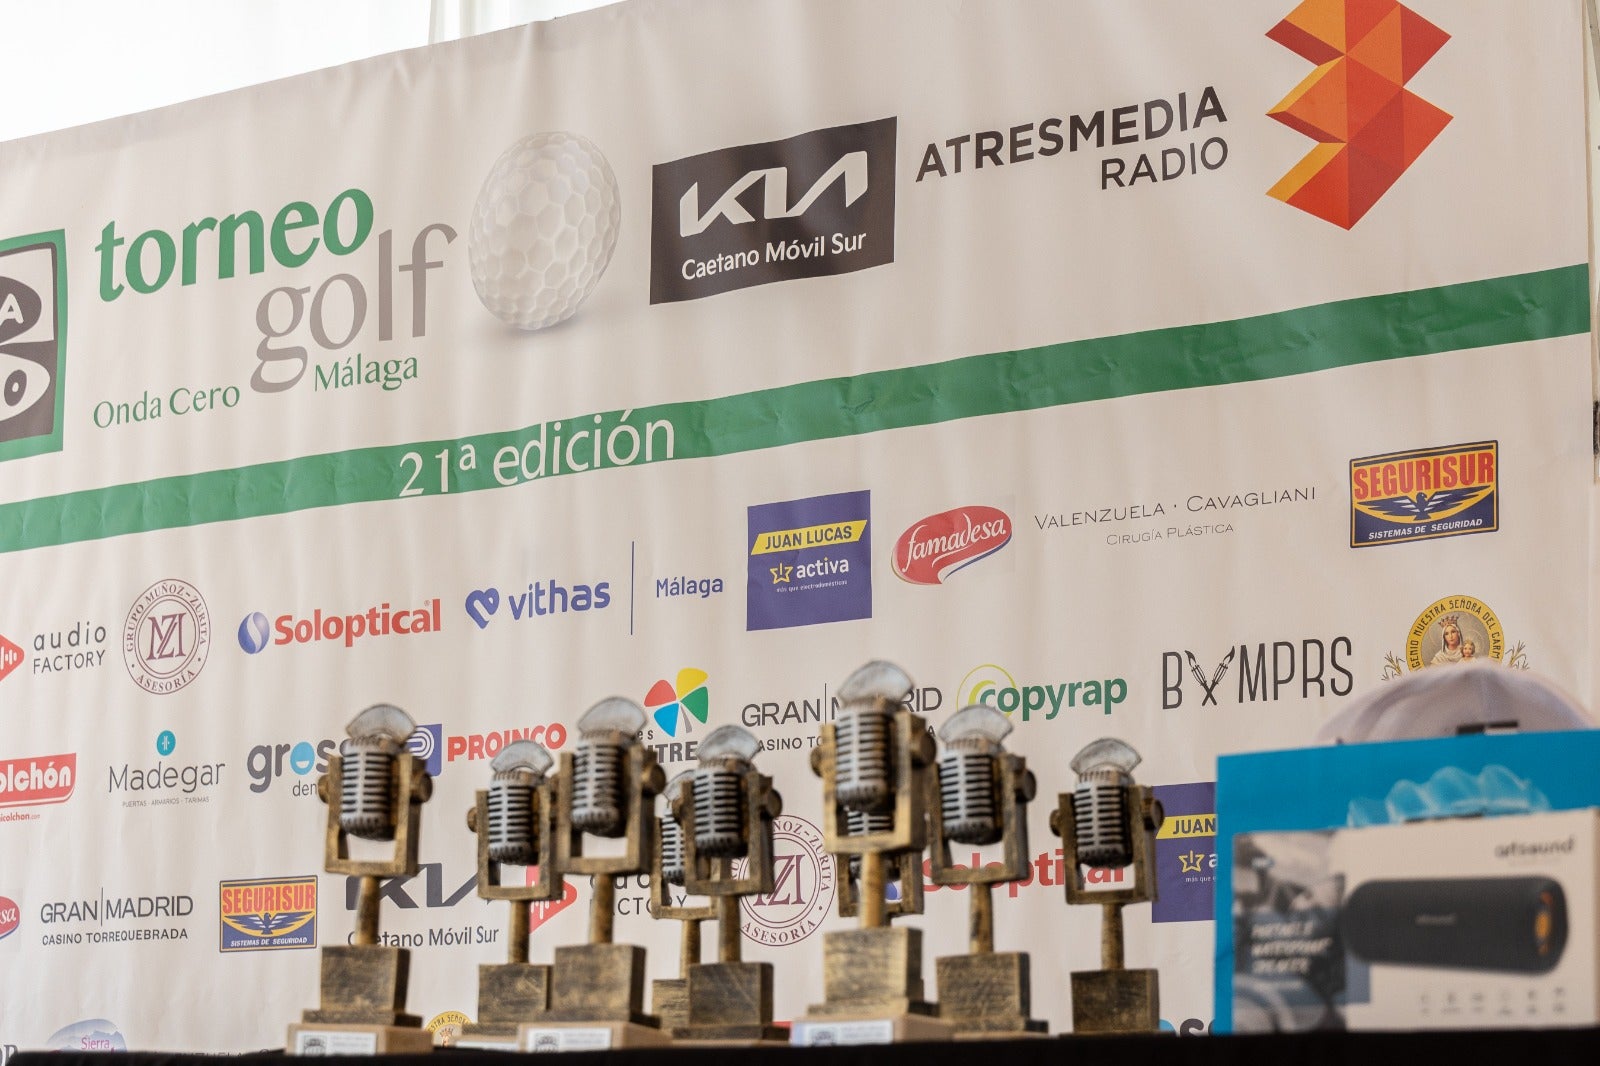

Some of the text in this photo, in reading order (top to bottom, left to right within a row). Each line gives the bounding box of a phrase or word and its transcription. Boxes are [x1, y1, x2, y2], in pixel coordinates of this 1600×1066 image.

[916, 86, 1227, 182] ATRESMEDIA
[1101, 136, 1228, 190] RADIO
[679, 150, 868, 237] KIA
[95, 188, 374, 302] torneo
[681, 232, 866, 280] Caetano Móvil Sur
[250, 223, 457, 393] golf
[314, 353, 419, 391] Málaga
[93, 385, 240, 429] Onda Cero
[399, 409, 675, 497] 21ª edición
[1353, 452, 1494, 500] SEGURISUR
[1034, 486, 1316, 530] VALENZUELA CAVAGLIANI
[765, 525, 852, 550] JUAN LUCAS
[902, 512, 1007, 573] famadesa
[1368, 518, 1483, 540] SISTEMAS DE SEGURIDAD
[796, 557, 850, 579] activa
[508, 579, 611, 621] vithas
[655, 576, 724, 598] Málaga
[34, 621, 106, 651] audio
[127, 604, 144, 652] GRUPO
[275, 598, 441, 647] Soloptical
[1409, 598, 1502, 669] GENIO NUESTRA SEÑORA DEL CARM
[33, 649, 106, 674] FACTORY
[136, 669, 196, 692] ASESORÍA
[741, 699, 820, 727] GRAN
[979, 677, 1128, 721] copyrap
[648, 740, 699, 763] TRE
[758, 737, 802, 752] ASINO
[109, 761, 226, 793] Madegar
[247, 739, 347, 793] gros
[292, 779, 317, 797] den
[1173, 817, 1216, 835] JUAN
[40, 895, 194, 924] GRAN MADRID
[222, 884, 315, 914] SEGURISUR
[42, 928, 188, 945] CASINO TORREQUEBRADA
[231, 938, 260, 947] SISTEMAS
[273, 936, 308, 945] SEGURIDAD
[348, 925, 499, 947] etano Móvil Sur
[742, 919, 817, 943] ASESORÍA
[81, 1035, 110, 1050] Sierra
